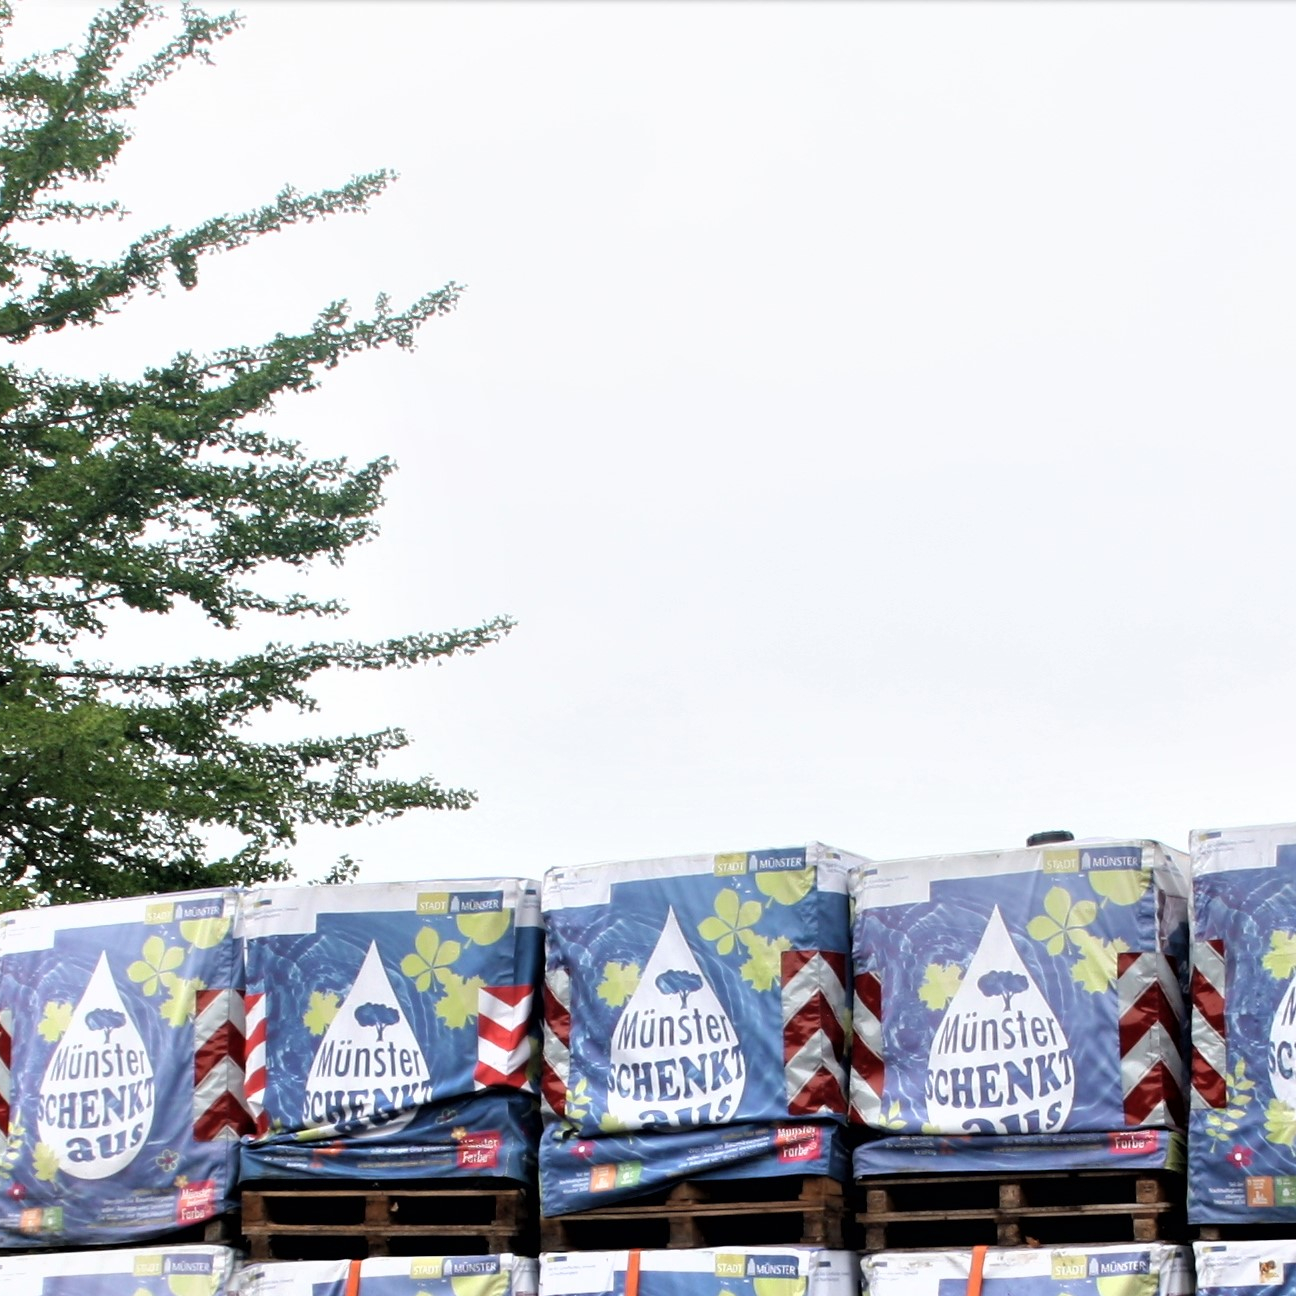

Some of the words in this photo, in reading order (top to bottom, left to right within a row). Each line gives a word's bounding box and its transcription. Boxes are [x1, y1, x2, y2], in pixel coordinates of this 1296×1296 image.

[717, 862, 745, 873] STADT
[759, 857, 802, 869] MÜNSTER
[1047, 858, 1075, 870] STADT
[1093, 854, 1138, 868] MÜNSTER
[183, 905, 220, 918] MÜNSTER
[420, 901, 446, 911] STADT
[460, 896, 499, 911] MÜNSTER
[618, 1009, 731, 1049] Münster
[938, 1009, 1057, 1054] Münster
[50, 1043, 145, 1081] Münster
[316, 1040, 420, 1078] Münster
[607, 1046, 743, 1101] SCHENKT
[925, 1050, 1073, 1110] SCHENKT
[38, 1077, 154, 1129] SCHENKT
[66, 1122, 143, 1162] aus
[171, 1260, 211, 1272] MÜNSTER
[413, 1264, 440, 1275] STADT
[454, 1259, 498, 1273] MÜNSTER
[717, 1263, 744, 1274] STADT
[756, 1262, 797, 1276] MÜNSTER
[1055, 1264, 1084, 1276] STADT
[1100, 1261, 1147, 1274] MÜNSTER
